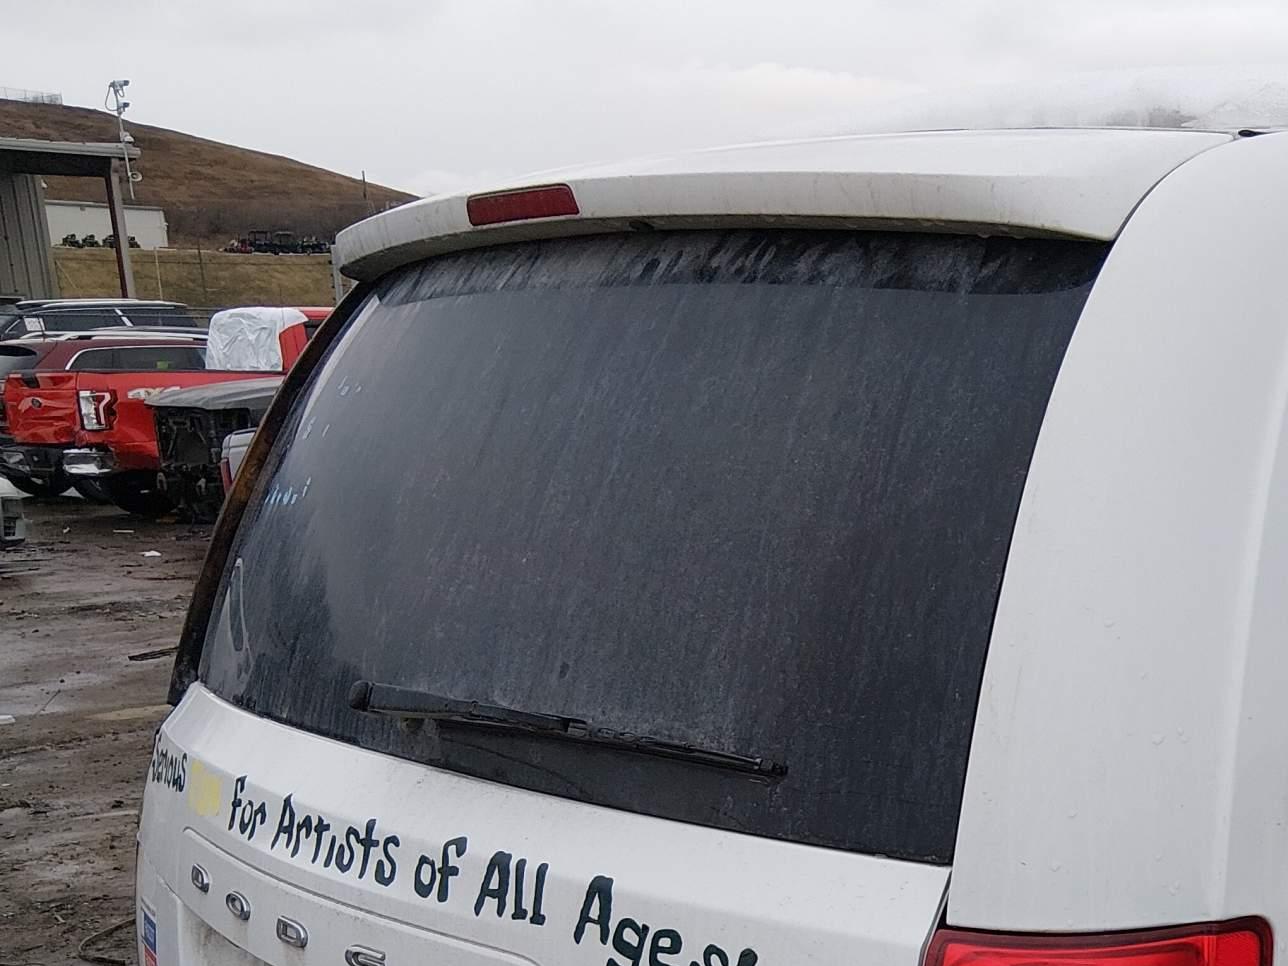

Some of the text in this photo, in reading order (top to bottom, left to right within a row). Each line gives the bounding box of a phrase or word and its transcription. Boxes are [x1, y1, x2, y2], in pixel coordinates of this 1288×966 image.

[271, 793, 400, 886] Artists
[414, 837, 468, 902] of
[474, 851, 549, 925] All
